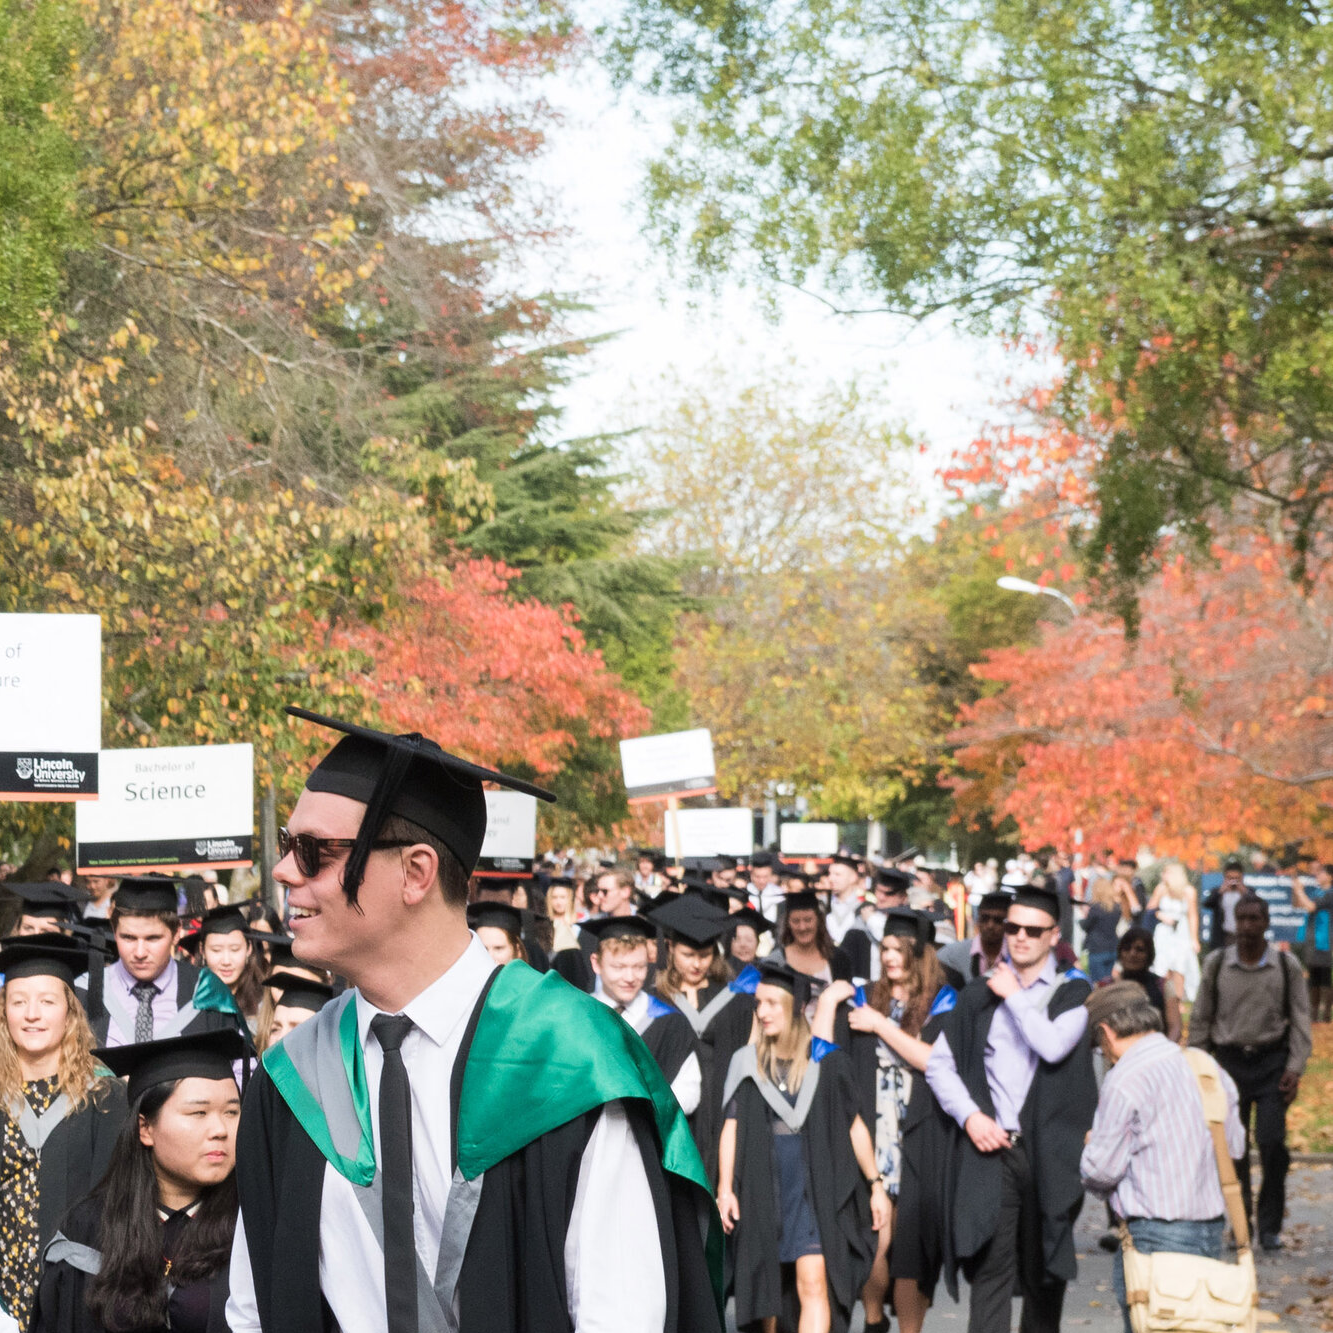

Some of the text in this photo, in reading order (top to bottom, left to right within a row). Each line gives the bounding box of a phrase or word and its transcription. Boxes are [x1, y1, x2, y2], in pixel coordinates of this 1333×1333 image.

[5, 642, 23, 659] of
[34, 757, 74, 770] Lincoln
[135, 761, 195, 773] Bachelor of
[34, 767, 86, 783] University
[125, 782, 205, 801] Science
